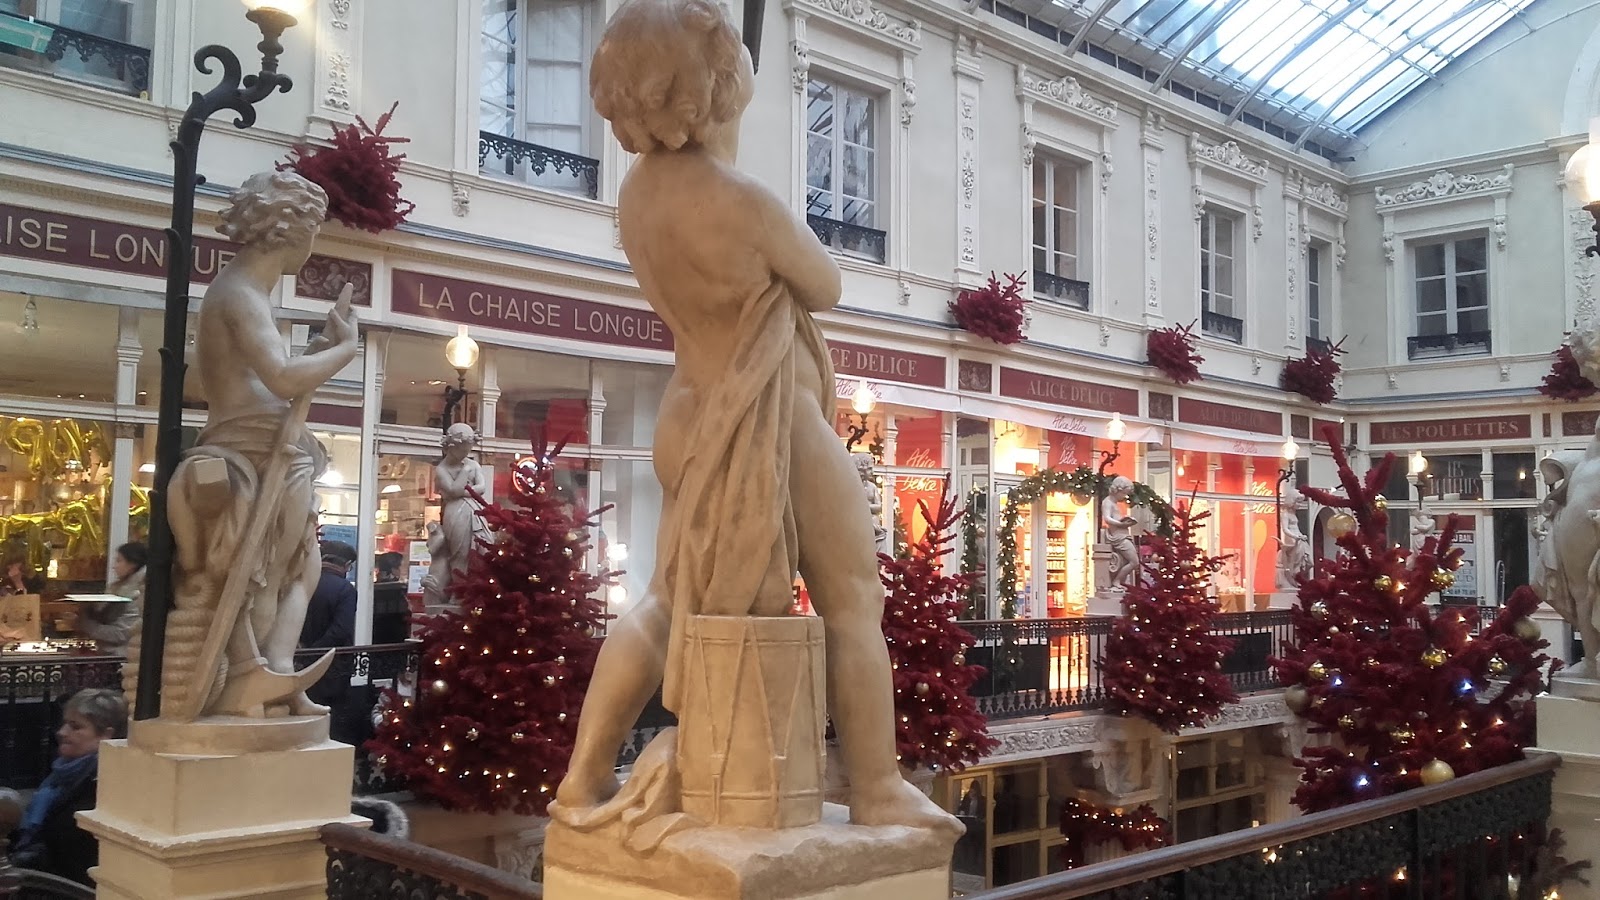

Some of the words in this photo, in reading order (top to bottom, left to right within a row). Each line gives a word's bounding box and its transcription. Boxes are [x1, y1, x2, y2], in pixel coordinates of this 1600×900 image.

[0, 214, 68, 253] ISE
[89, 229, 237, 275] LONUE
[418, 282, 455, 312] LA
[468, 291, 562, 328] CHAISE
[573, 308, 664, 343] LONGUE
[829, 347, 851, 368] CE
[856, 351, 918, 378] DELICE
[1027, 380, 1068, 400] ALICE
[1071, 386, 1118, 407] DELICE
[1052, 414, 1070, 431] Alice
[1381, 426, 1411, 440] LES
[1416, 420, 1519, 438] POULETTES
[906, 447, 937, 468] Alice
